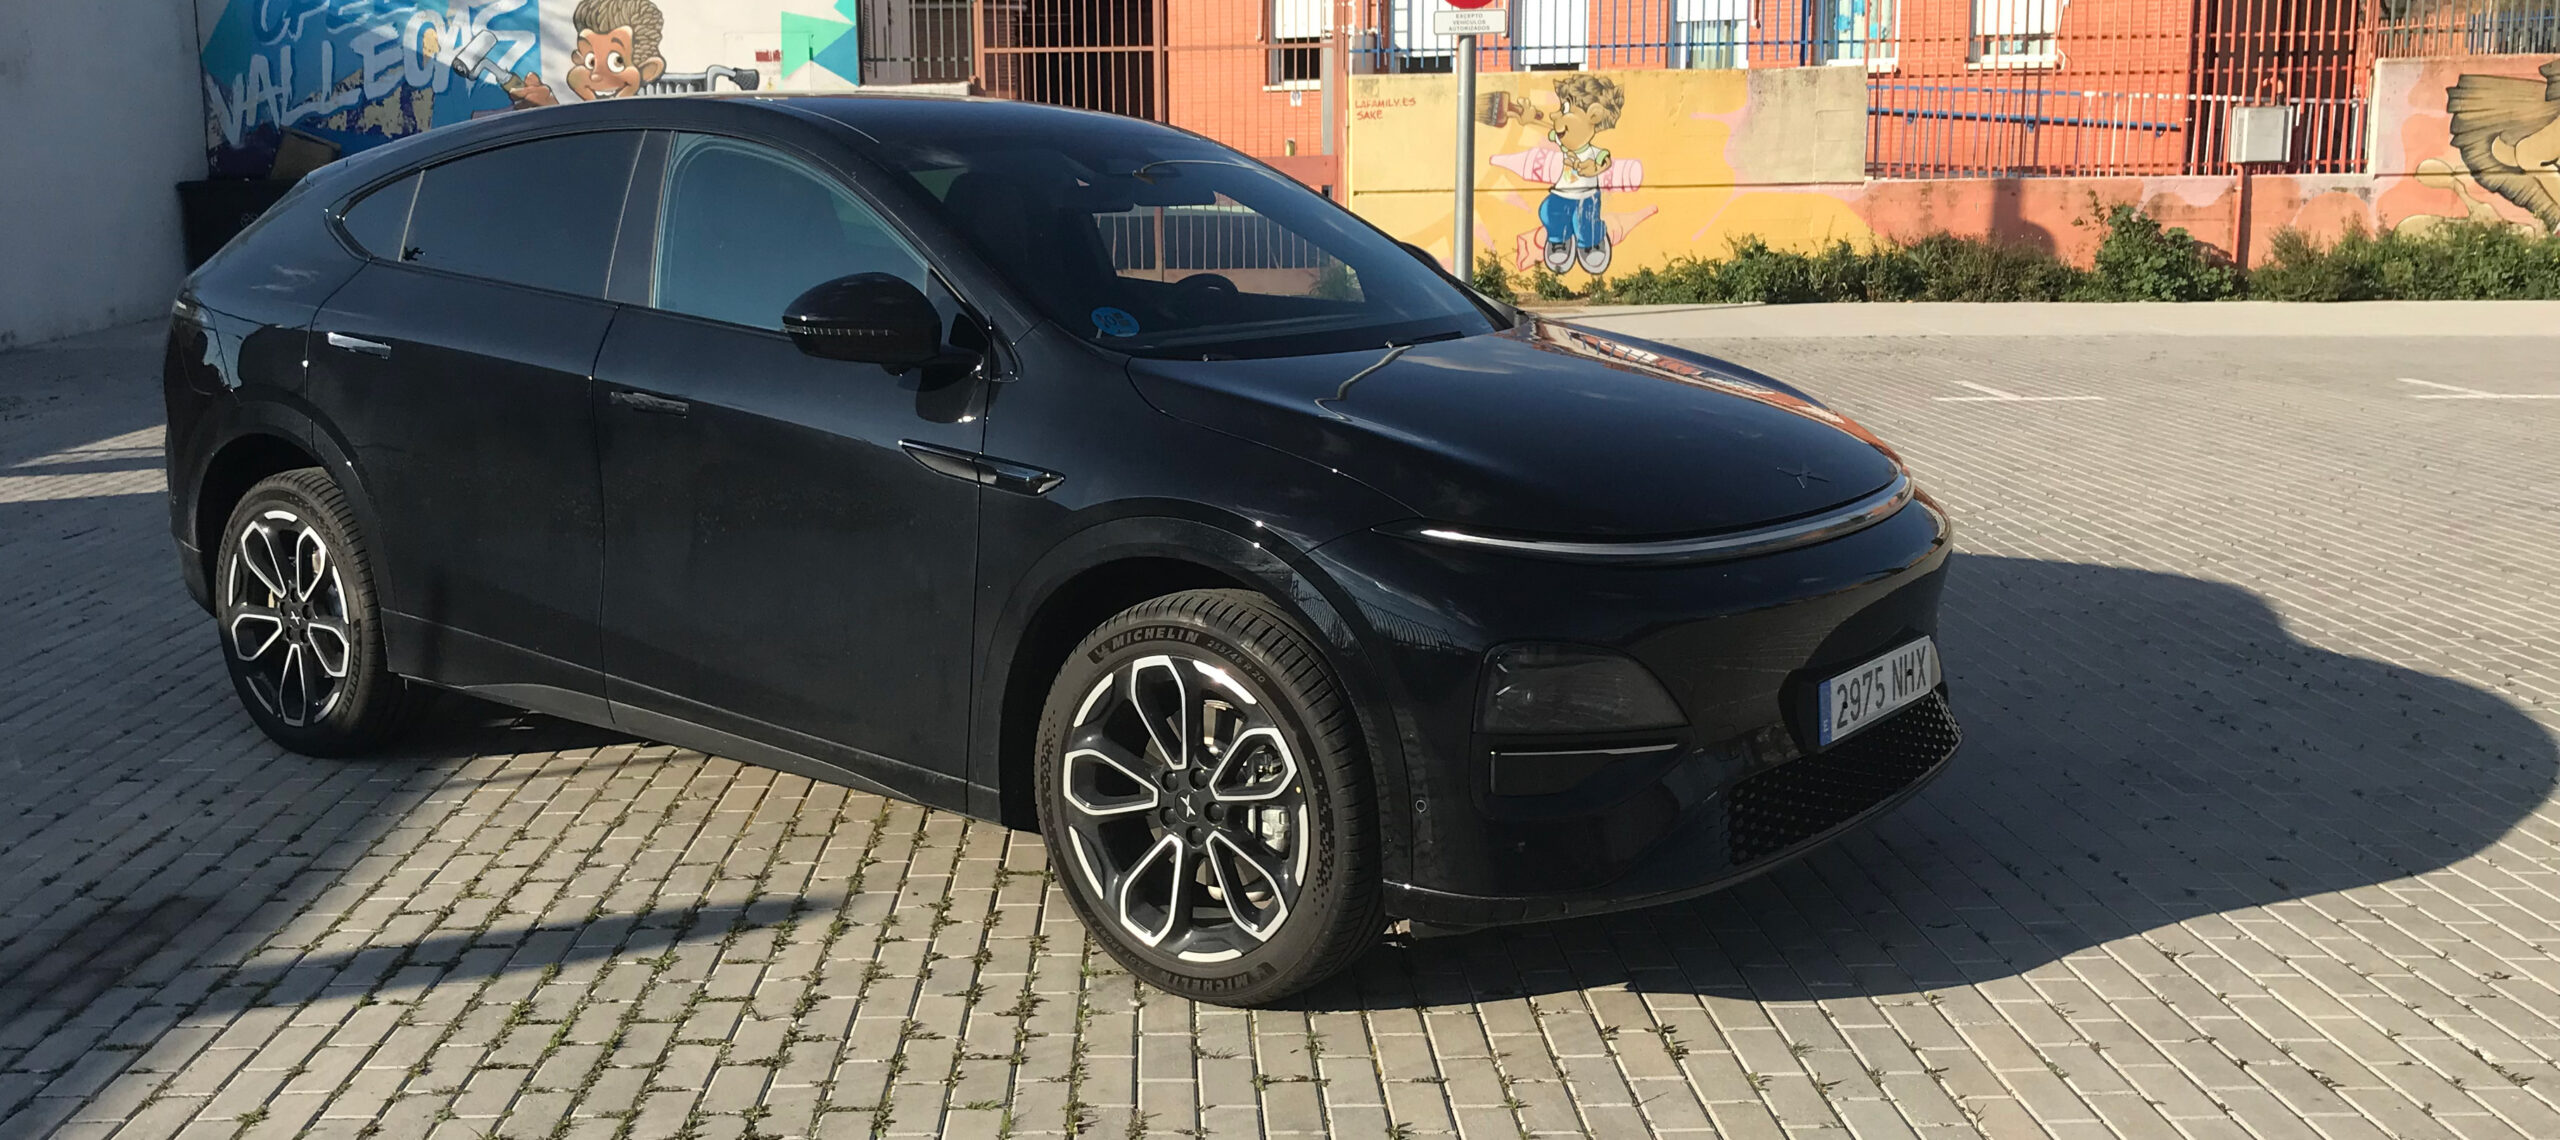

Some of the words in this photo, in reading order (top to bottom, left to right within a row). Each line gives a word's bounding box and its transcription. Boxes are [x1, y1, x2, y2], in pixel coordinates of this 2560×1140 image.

[1357, 110, 1383, 120] SAKE
[1112, 627, 1199, 649] MICHELIN
[1836, 666, 1886, 730] 2975
[1892, 646, 1927, 701] NHX
[1161, 971, 1249, 991] MICHELIN
